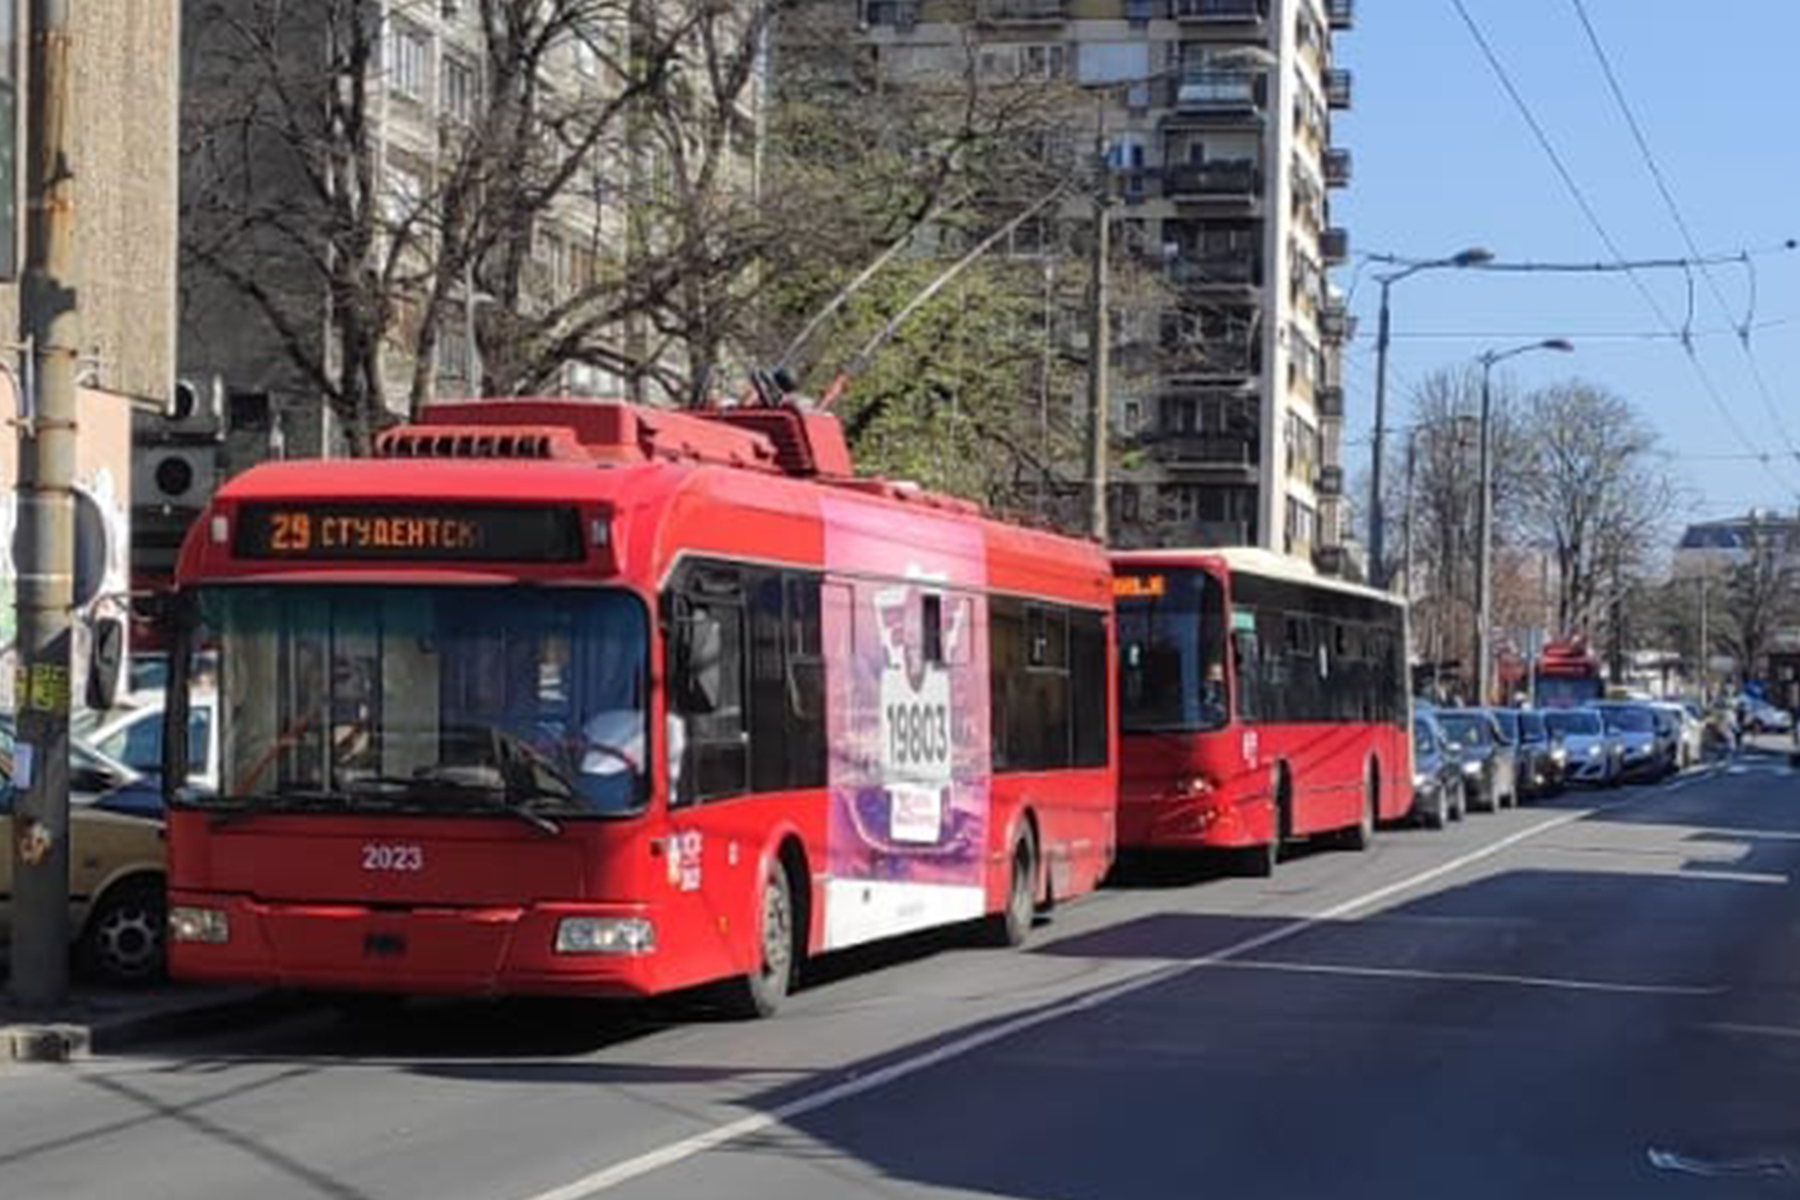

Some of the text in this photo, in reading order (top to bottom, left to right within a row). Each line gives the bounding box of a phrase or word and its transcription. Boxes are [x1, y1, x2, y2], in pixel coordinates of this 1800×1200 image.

[271, 513, 309, 549] 29
[887, 702, 948, 765] 19803
[361, 844, 424, 871] 2023
